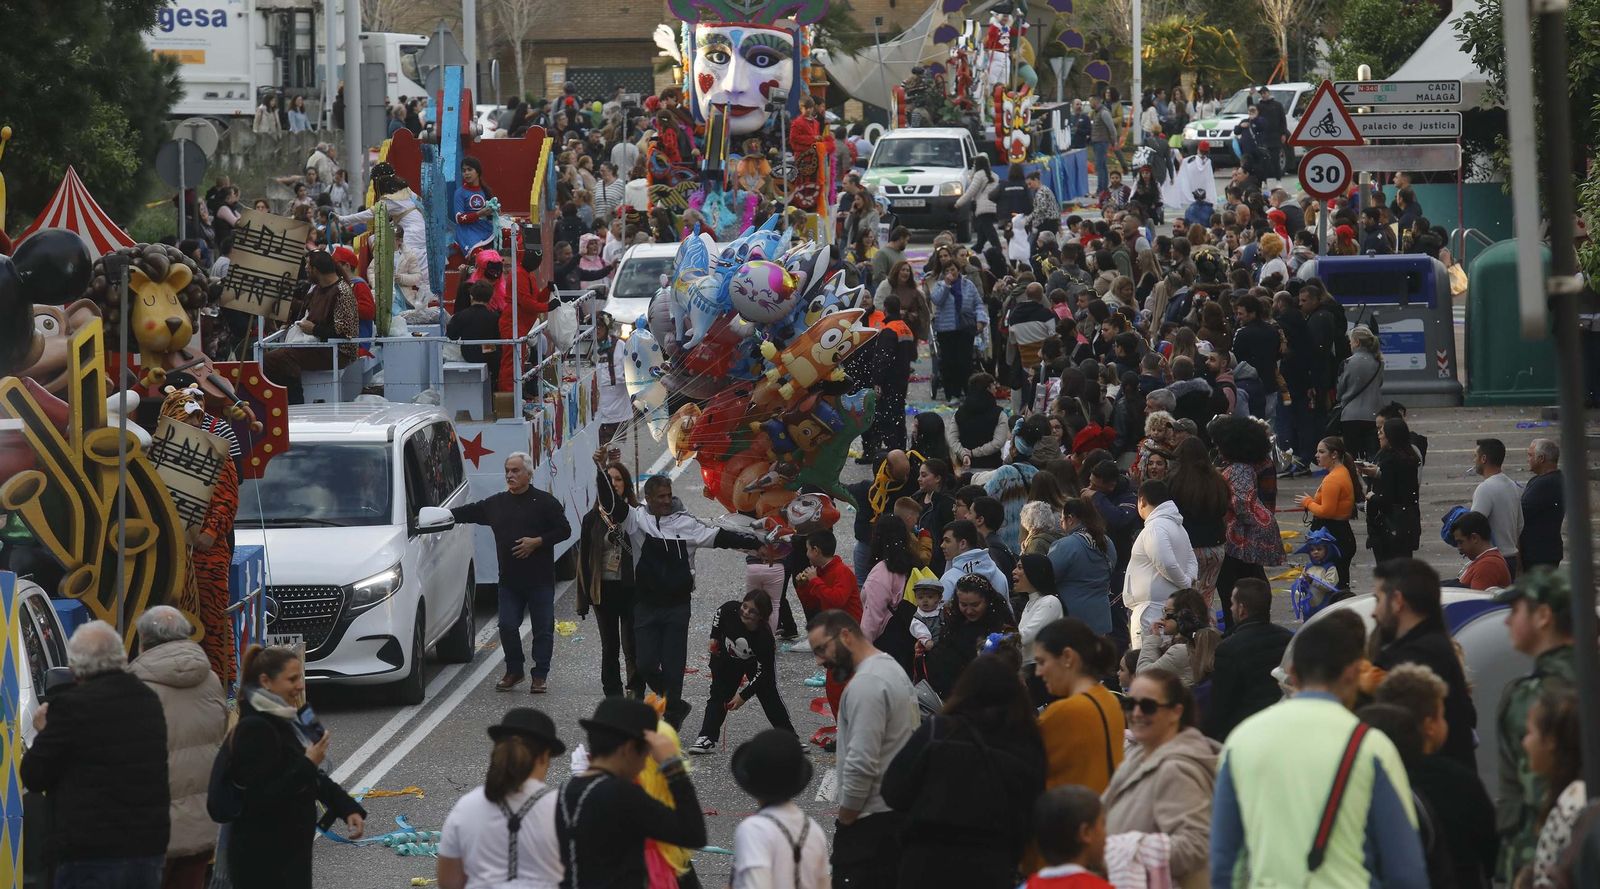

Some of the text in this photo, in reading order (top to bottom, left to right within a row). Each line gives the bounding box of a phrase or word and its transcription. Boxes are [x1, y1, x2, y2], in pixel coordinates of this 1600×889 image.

[1362, 122, 1456, 131] palacio de justicia
[1310, 165, 1340, 183] 30
